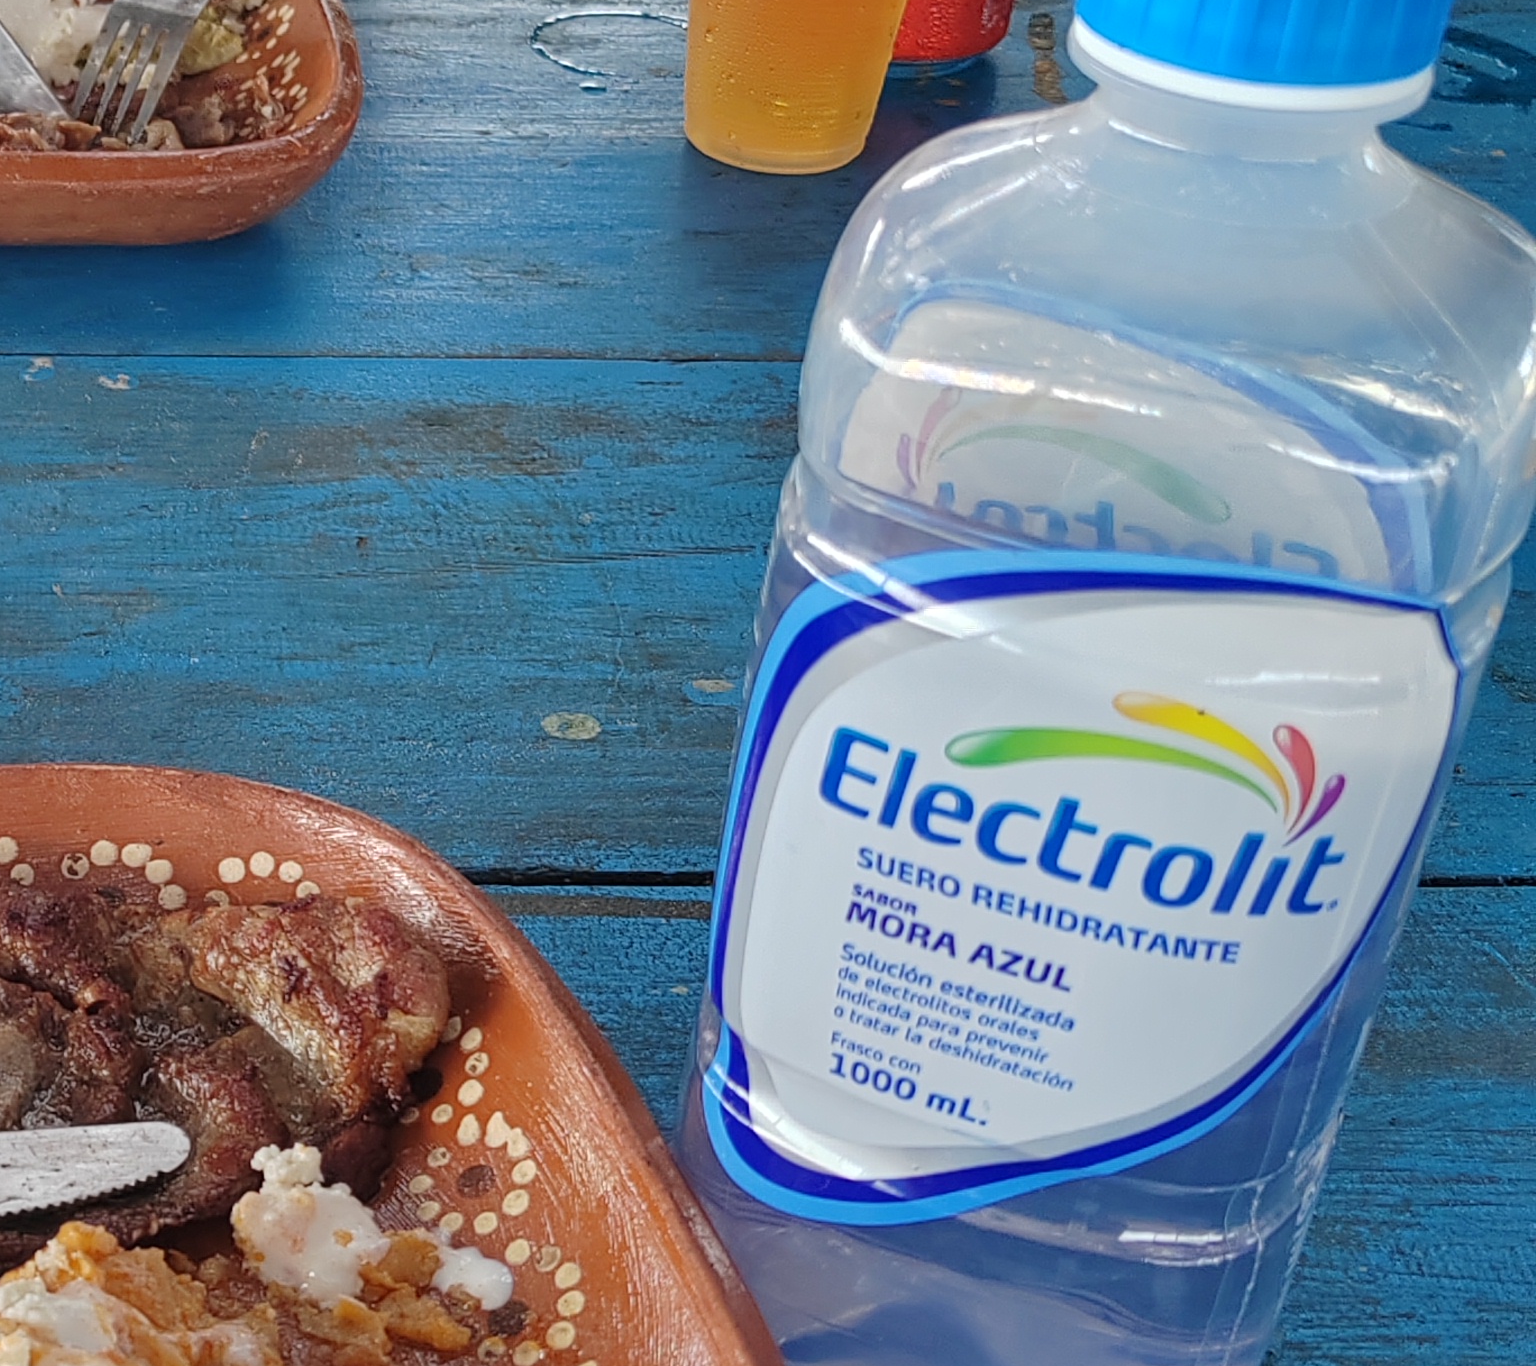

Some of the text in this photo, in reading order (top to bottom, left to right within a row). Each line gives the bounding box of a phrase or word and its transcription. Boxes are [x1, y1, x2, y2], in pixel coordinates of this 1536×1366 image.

[818, 726, 1346, 917] Electrolit
[852, 884, 918, 916] SABOR
[856, 846, 1241, 965] SUERO REHIDRATANTE
[840, 942, 1076, 1033] Solución esterilizada
[845, 901, 1073, 993] MORA AZUL
[835, 983, 1050, 1065] indicada para prevenir
[837, 966, 1040, 1042] de electrolitos orales
[829, 1052, 987, 1127] 1000 mL.
[830, 1031, 922, 1076] Frasco con
[833, 1005, 1074, 1093] o tratar la deshidratación
